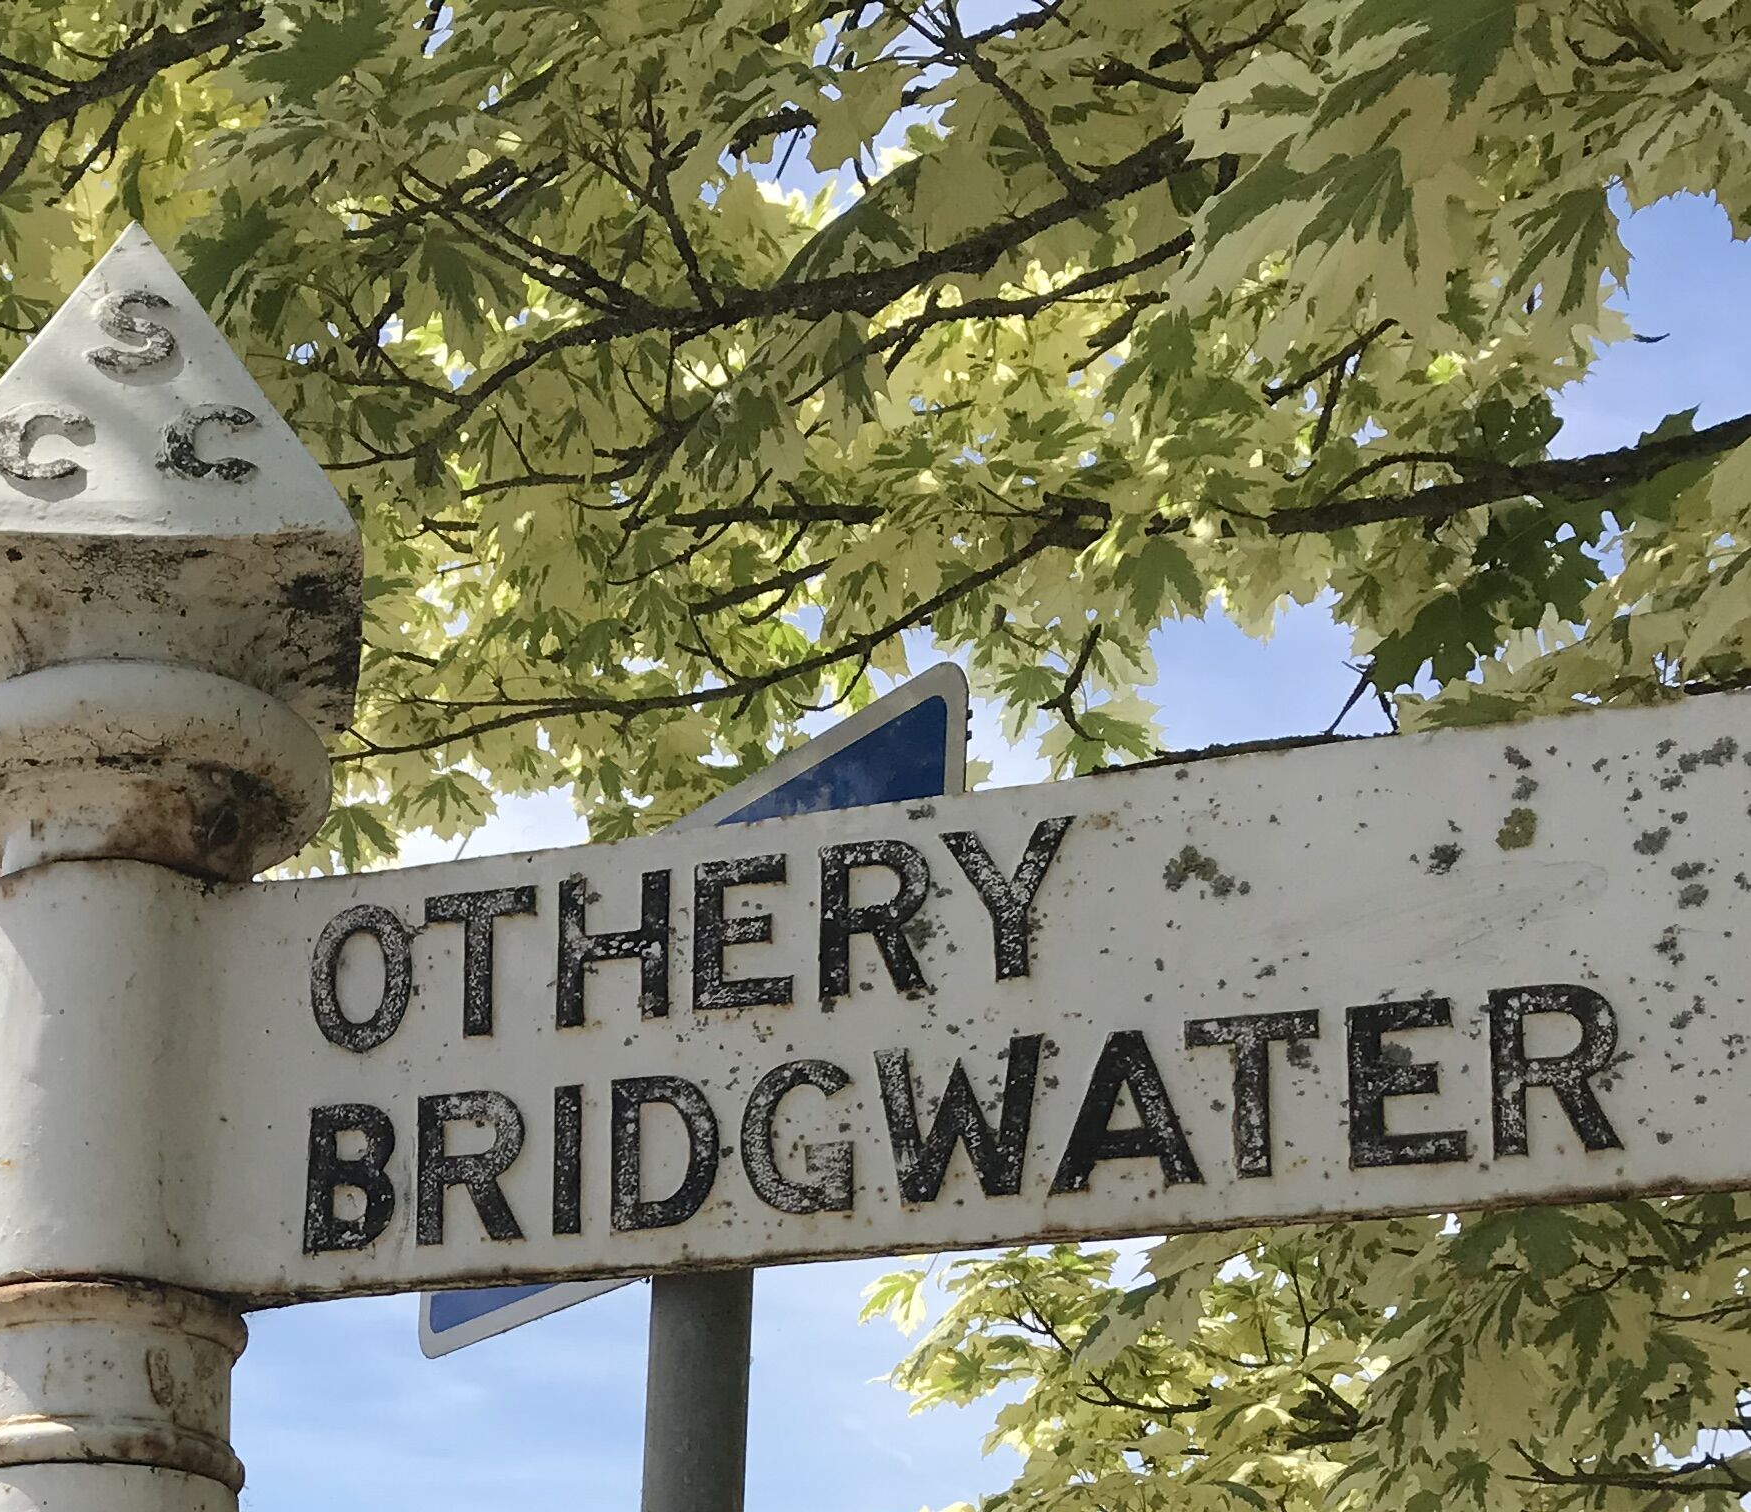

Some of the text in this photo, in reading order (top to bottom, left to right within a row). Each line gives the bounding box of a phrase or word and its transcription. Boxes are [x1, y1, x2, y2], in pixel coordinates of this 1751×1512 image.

[87, 289, 179, 376] S
[157, 403, 257, 484] C
[310, 815, 1075, 1052] OTHERY
[302, 982, 1622, 1254] BRIDGWATER
